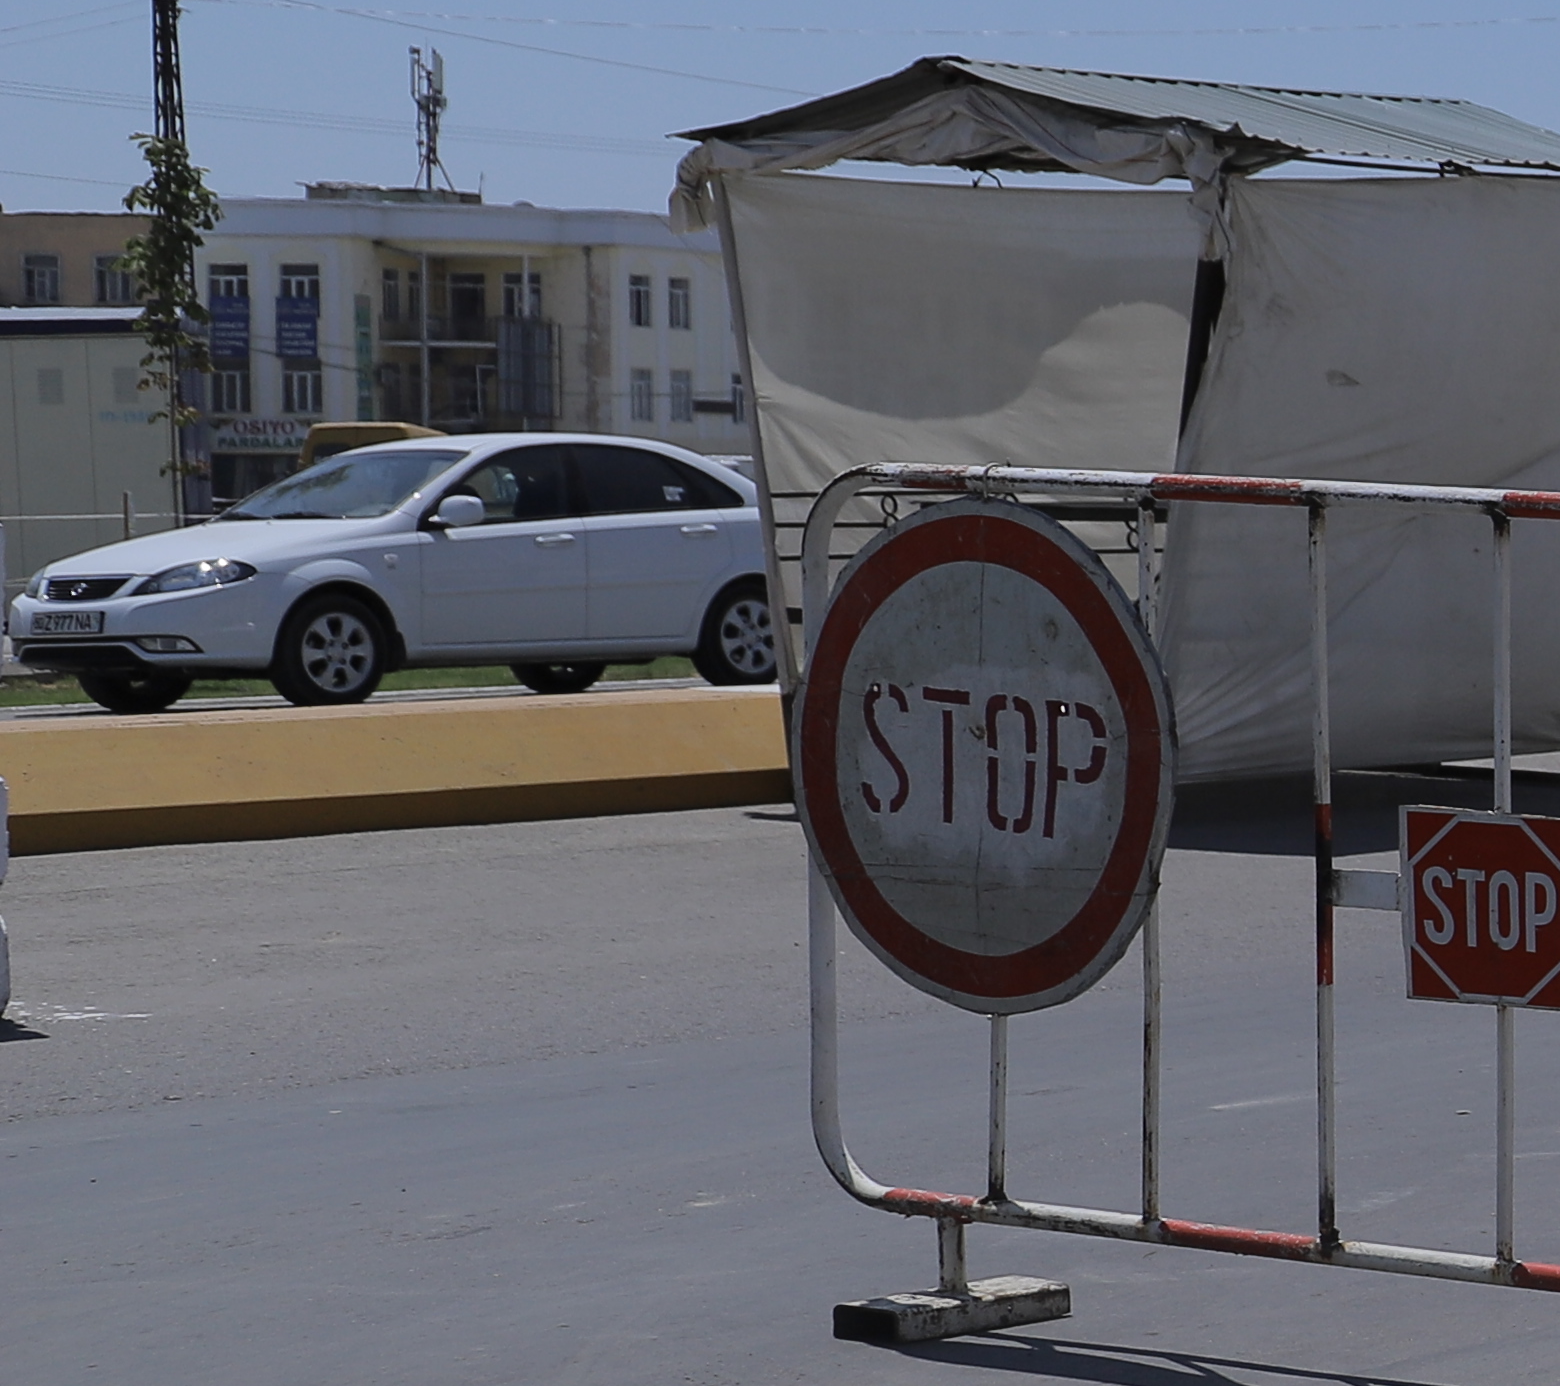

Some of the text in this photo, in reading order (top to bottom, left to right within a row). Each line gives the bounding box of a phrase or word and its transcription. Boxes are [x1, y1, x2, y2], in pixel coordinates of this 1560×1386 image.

[233, 419, 294, 434] OSIYO
[861, 682, 1107, 839] STOP
[1422, 865, 1557, 953] STOP
